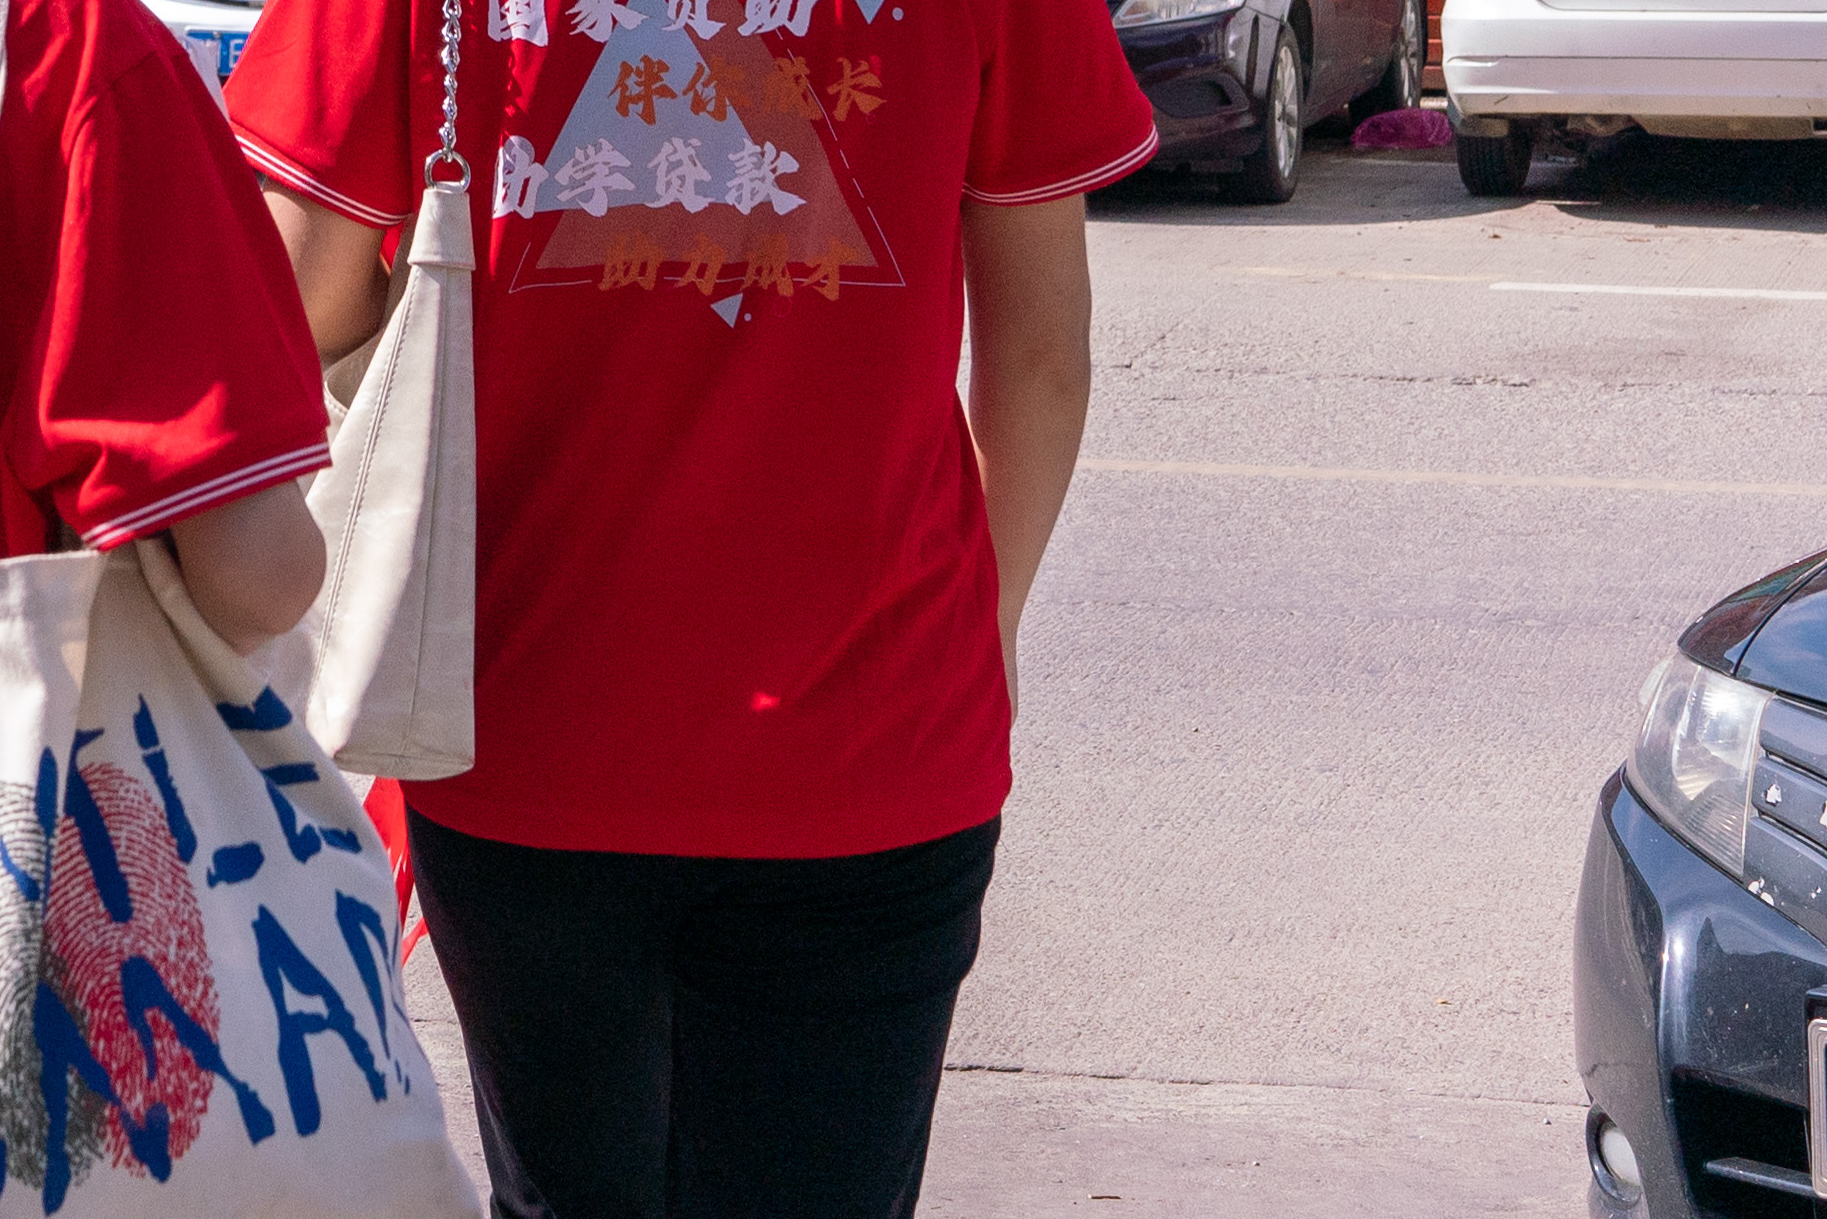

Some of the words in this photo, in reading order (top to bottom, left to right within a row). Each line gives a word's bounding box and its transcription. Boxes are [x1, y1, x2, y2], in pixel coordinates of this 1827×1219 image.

[608, 53, 888, 127] 伴你成长
[492, 137, 808, 219] 助学贷款
